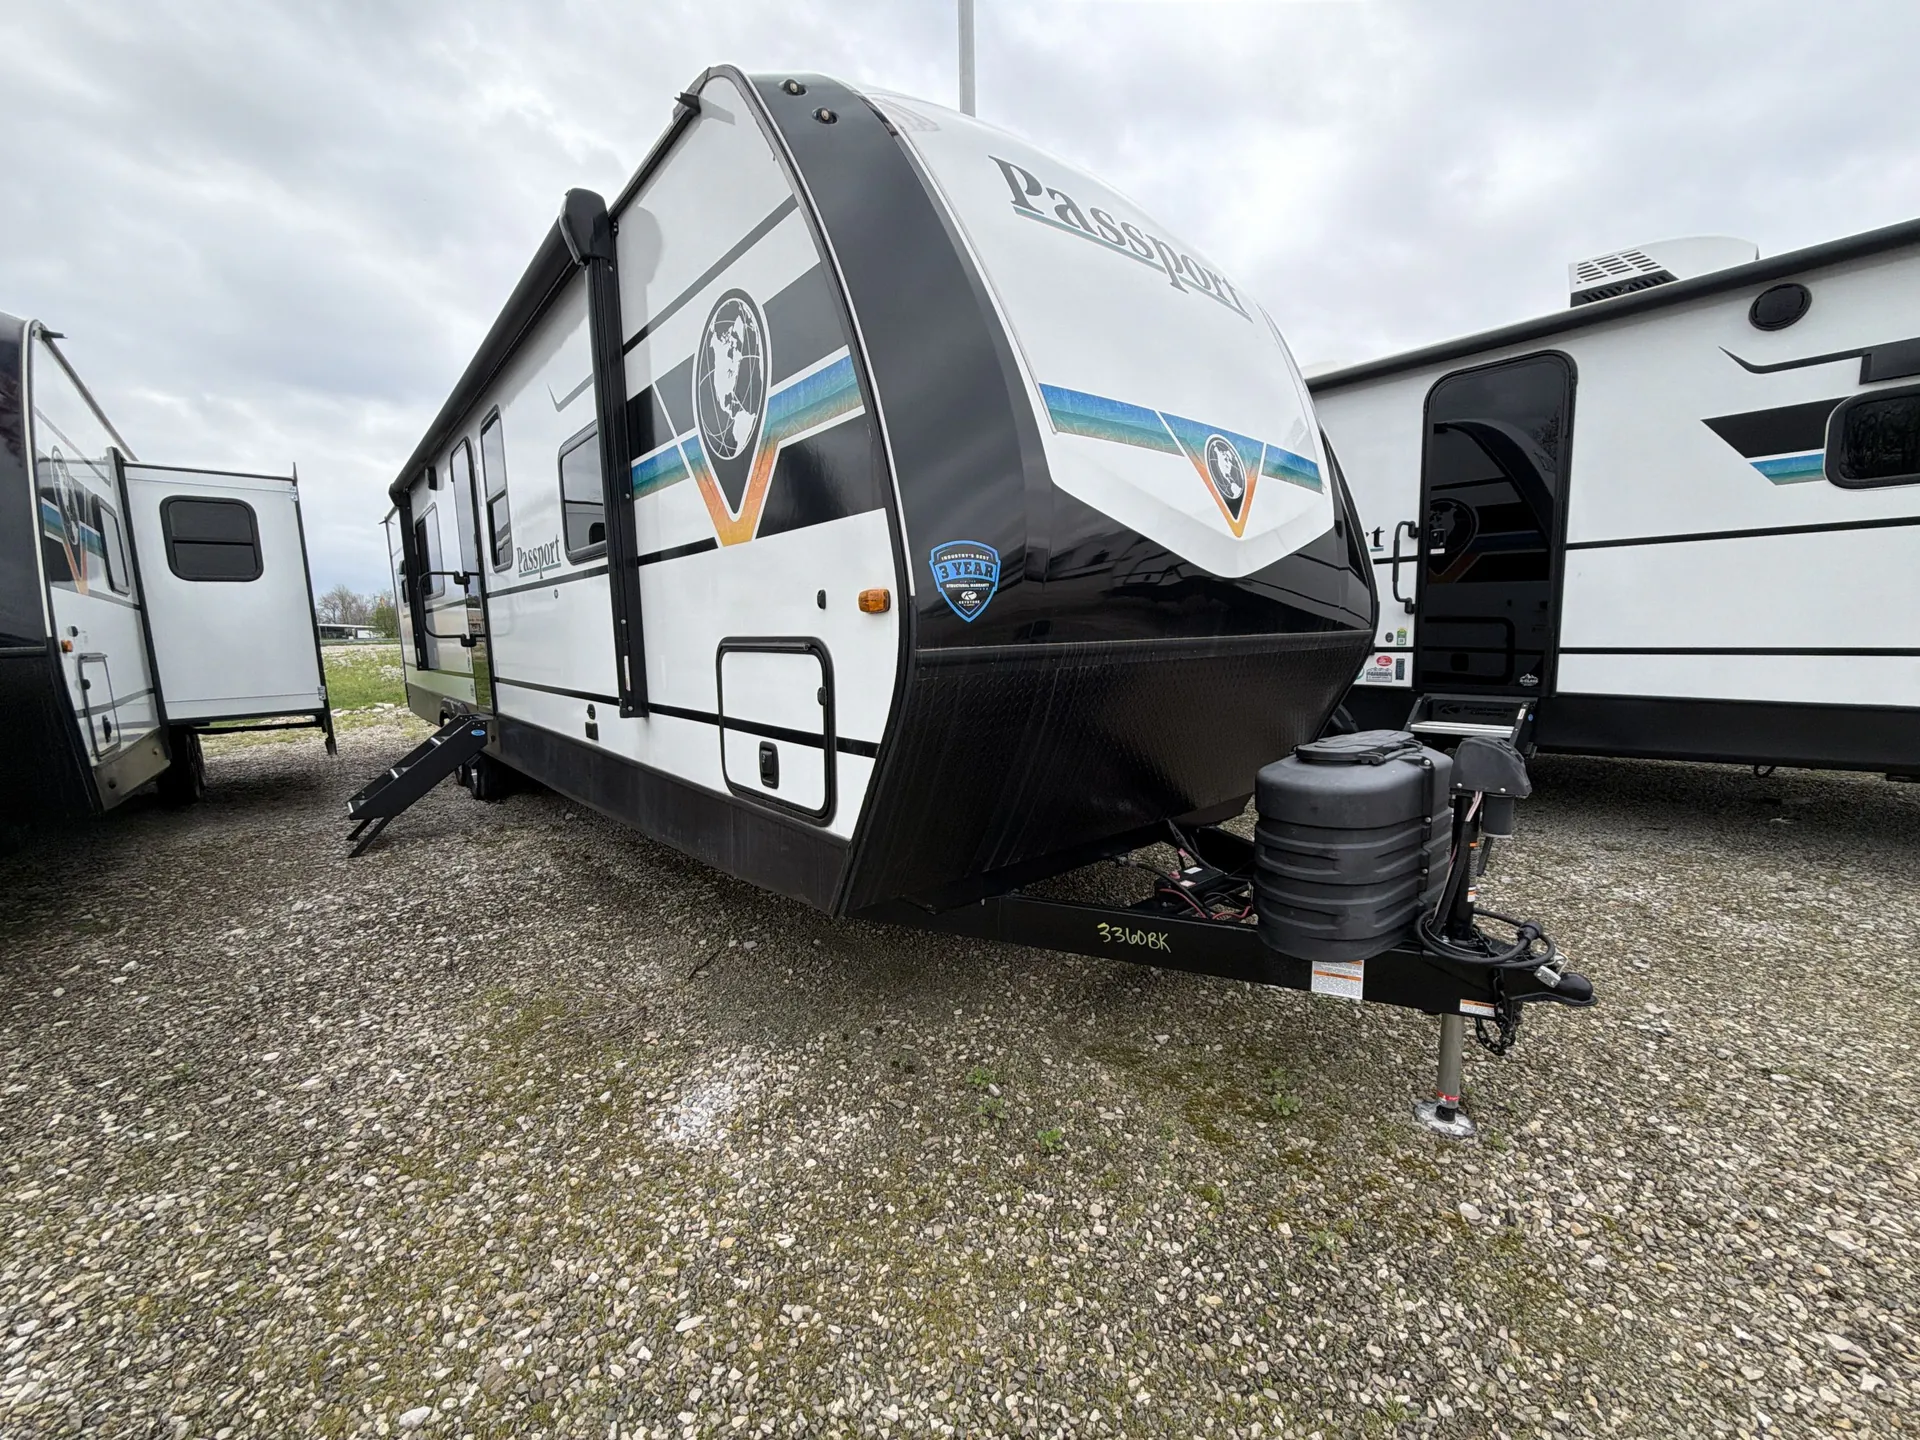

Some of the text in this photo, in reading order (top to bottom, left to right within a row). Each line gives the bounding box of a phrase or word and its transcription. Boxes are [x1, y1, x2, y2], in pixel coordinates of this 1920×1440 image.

[987, 154, 1252, 316] Passport
[516, 533, 561, 579] Passport
[938, 562, 994, 579] 3 YEAR
[941, 553, 990, 561] INDUSTRY'S BEST
[1097, 922, 1171, 953] 3360BK
